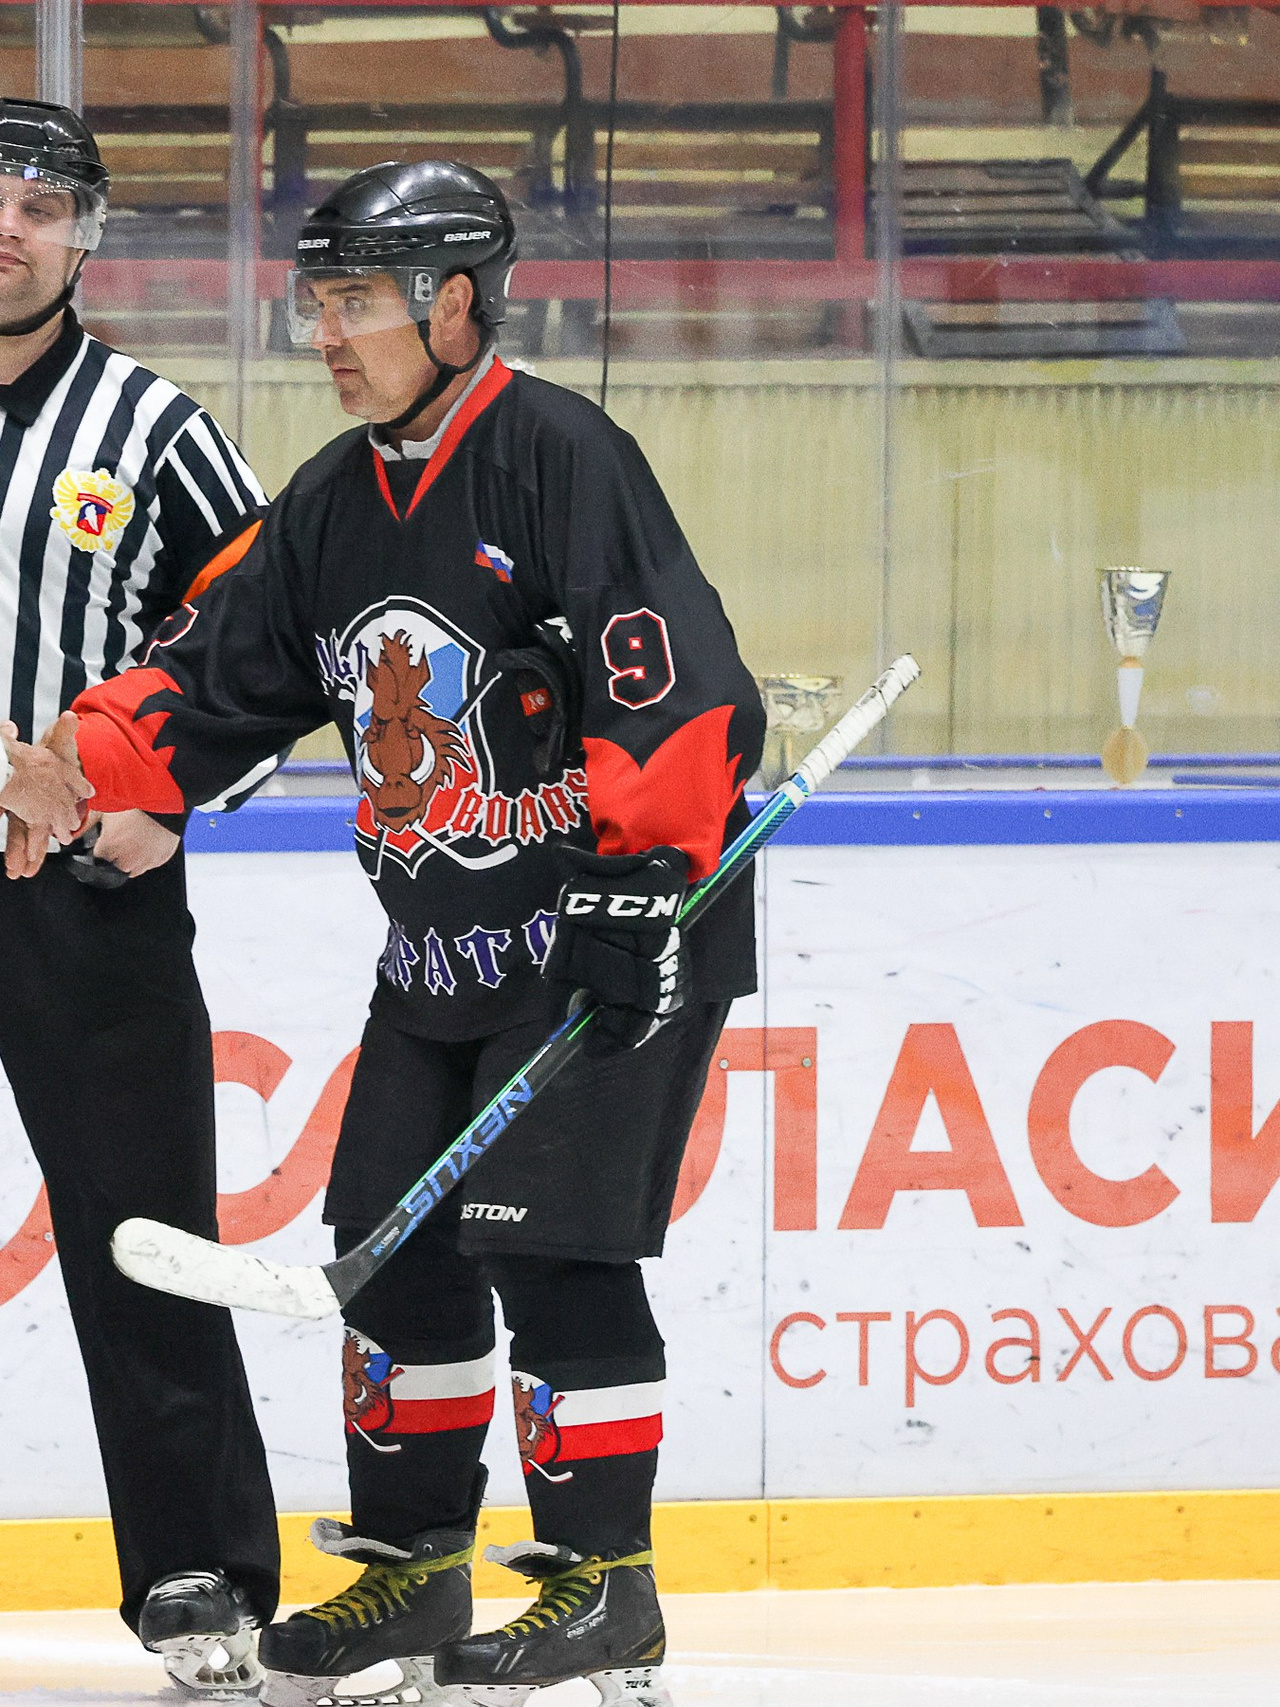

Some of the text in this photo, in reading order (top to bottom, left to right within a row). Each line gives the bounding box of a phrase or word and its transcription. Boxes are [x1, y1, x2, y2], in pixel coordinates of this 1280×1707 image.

[600, 607, 676, 710] 9
[565, 893, 679, 918] CCM
[400, 1074, 535, 1224] NEXUS
[460, 1203, 528, 1222] STON
[769, 1304, 1280, 1408] страхов
